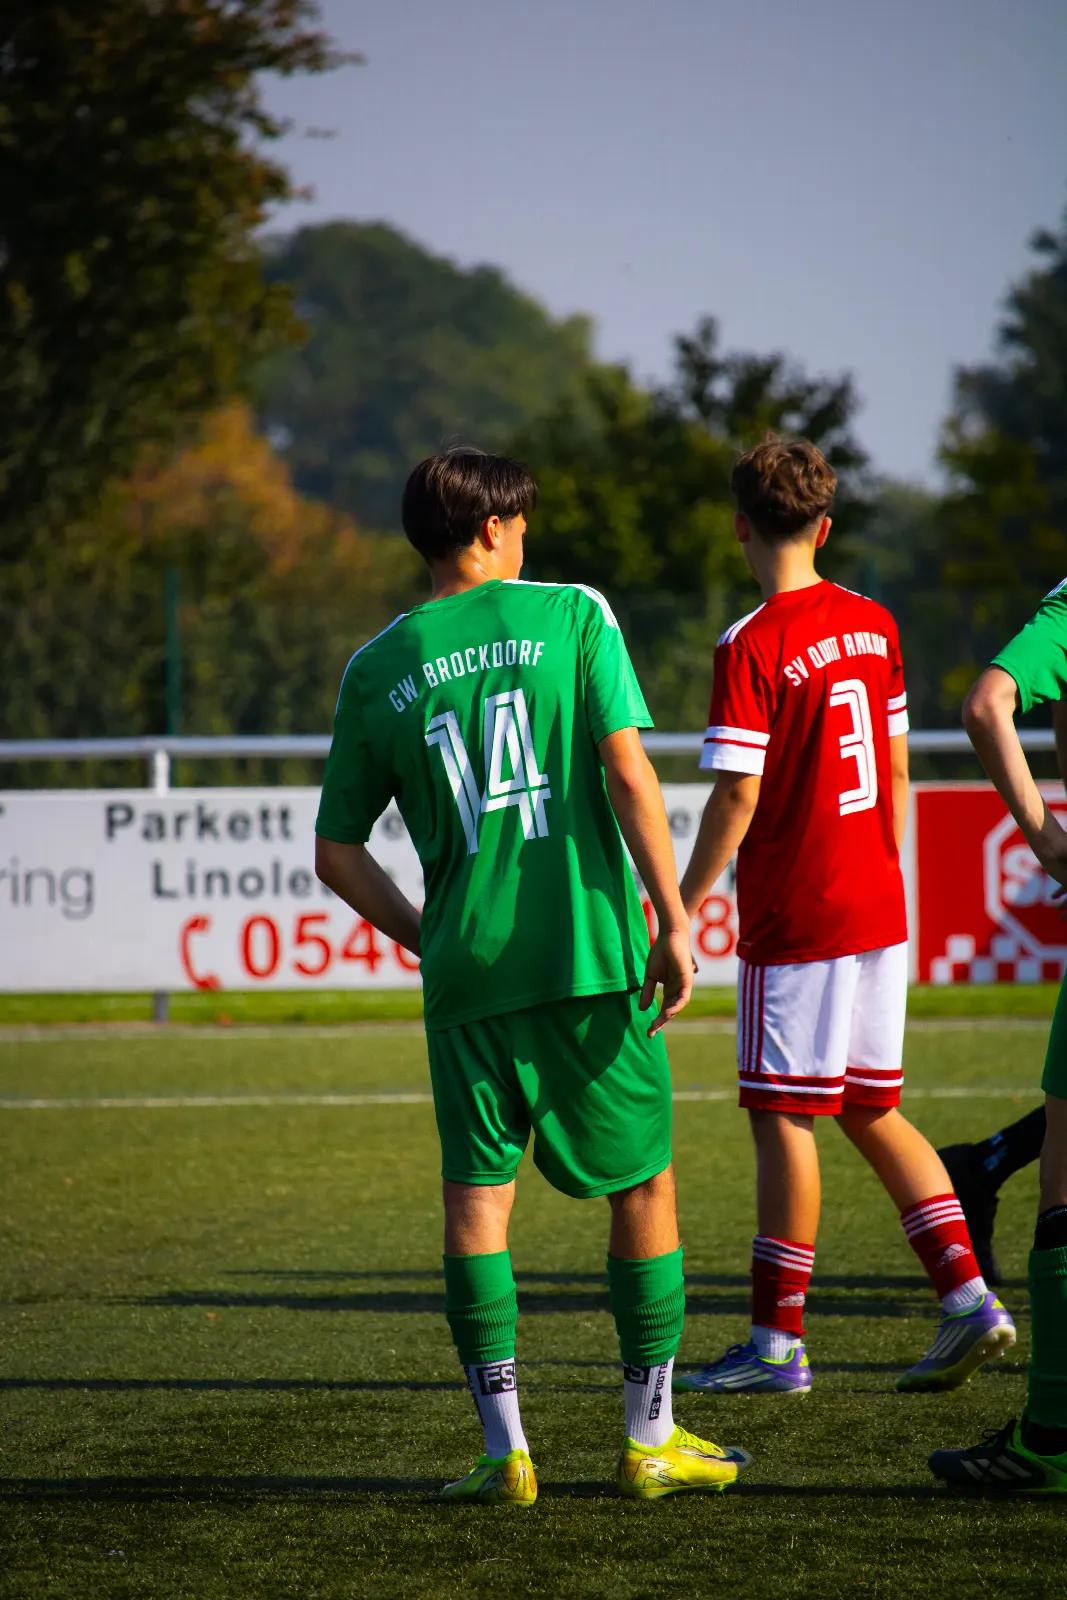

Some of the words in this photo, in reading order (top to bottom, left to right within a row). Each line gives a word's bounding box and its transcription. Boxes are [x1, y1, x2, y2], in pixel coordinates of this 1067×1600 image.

[388, 674, 418, 713] GW
[422, 639, 545, 689] BROCKDORF
[783, 656, 810, 687] SV
[829, 678, 878, 816] 3
[424, 688, 551, 856] 14
[105, 802, 294, 842] Parkett
[152, 860, 338, 899] Linole
[483, 1365, 515, 1393] FS
